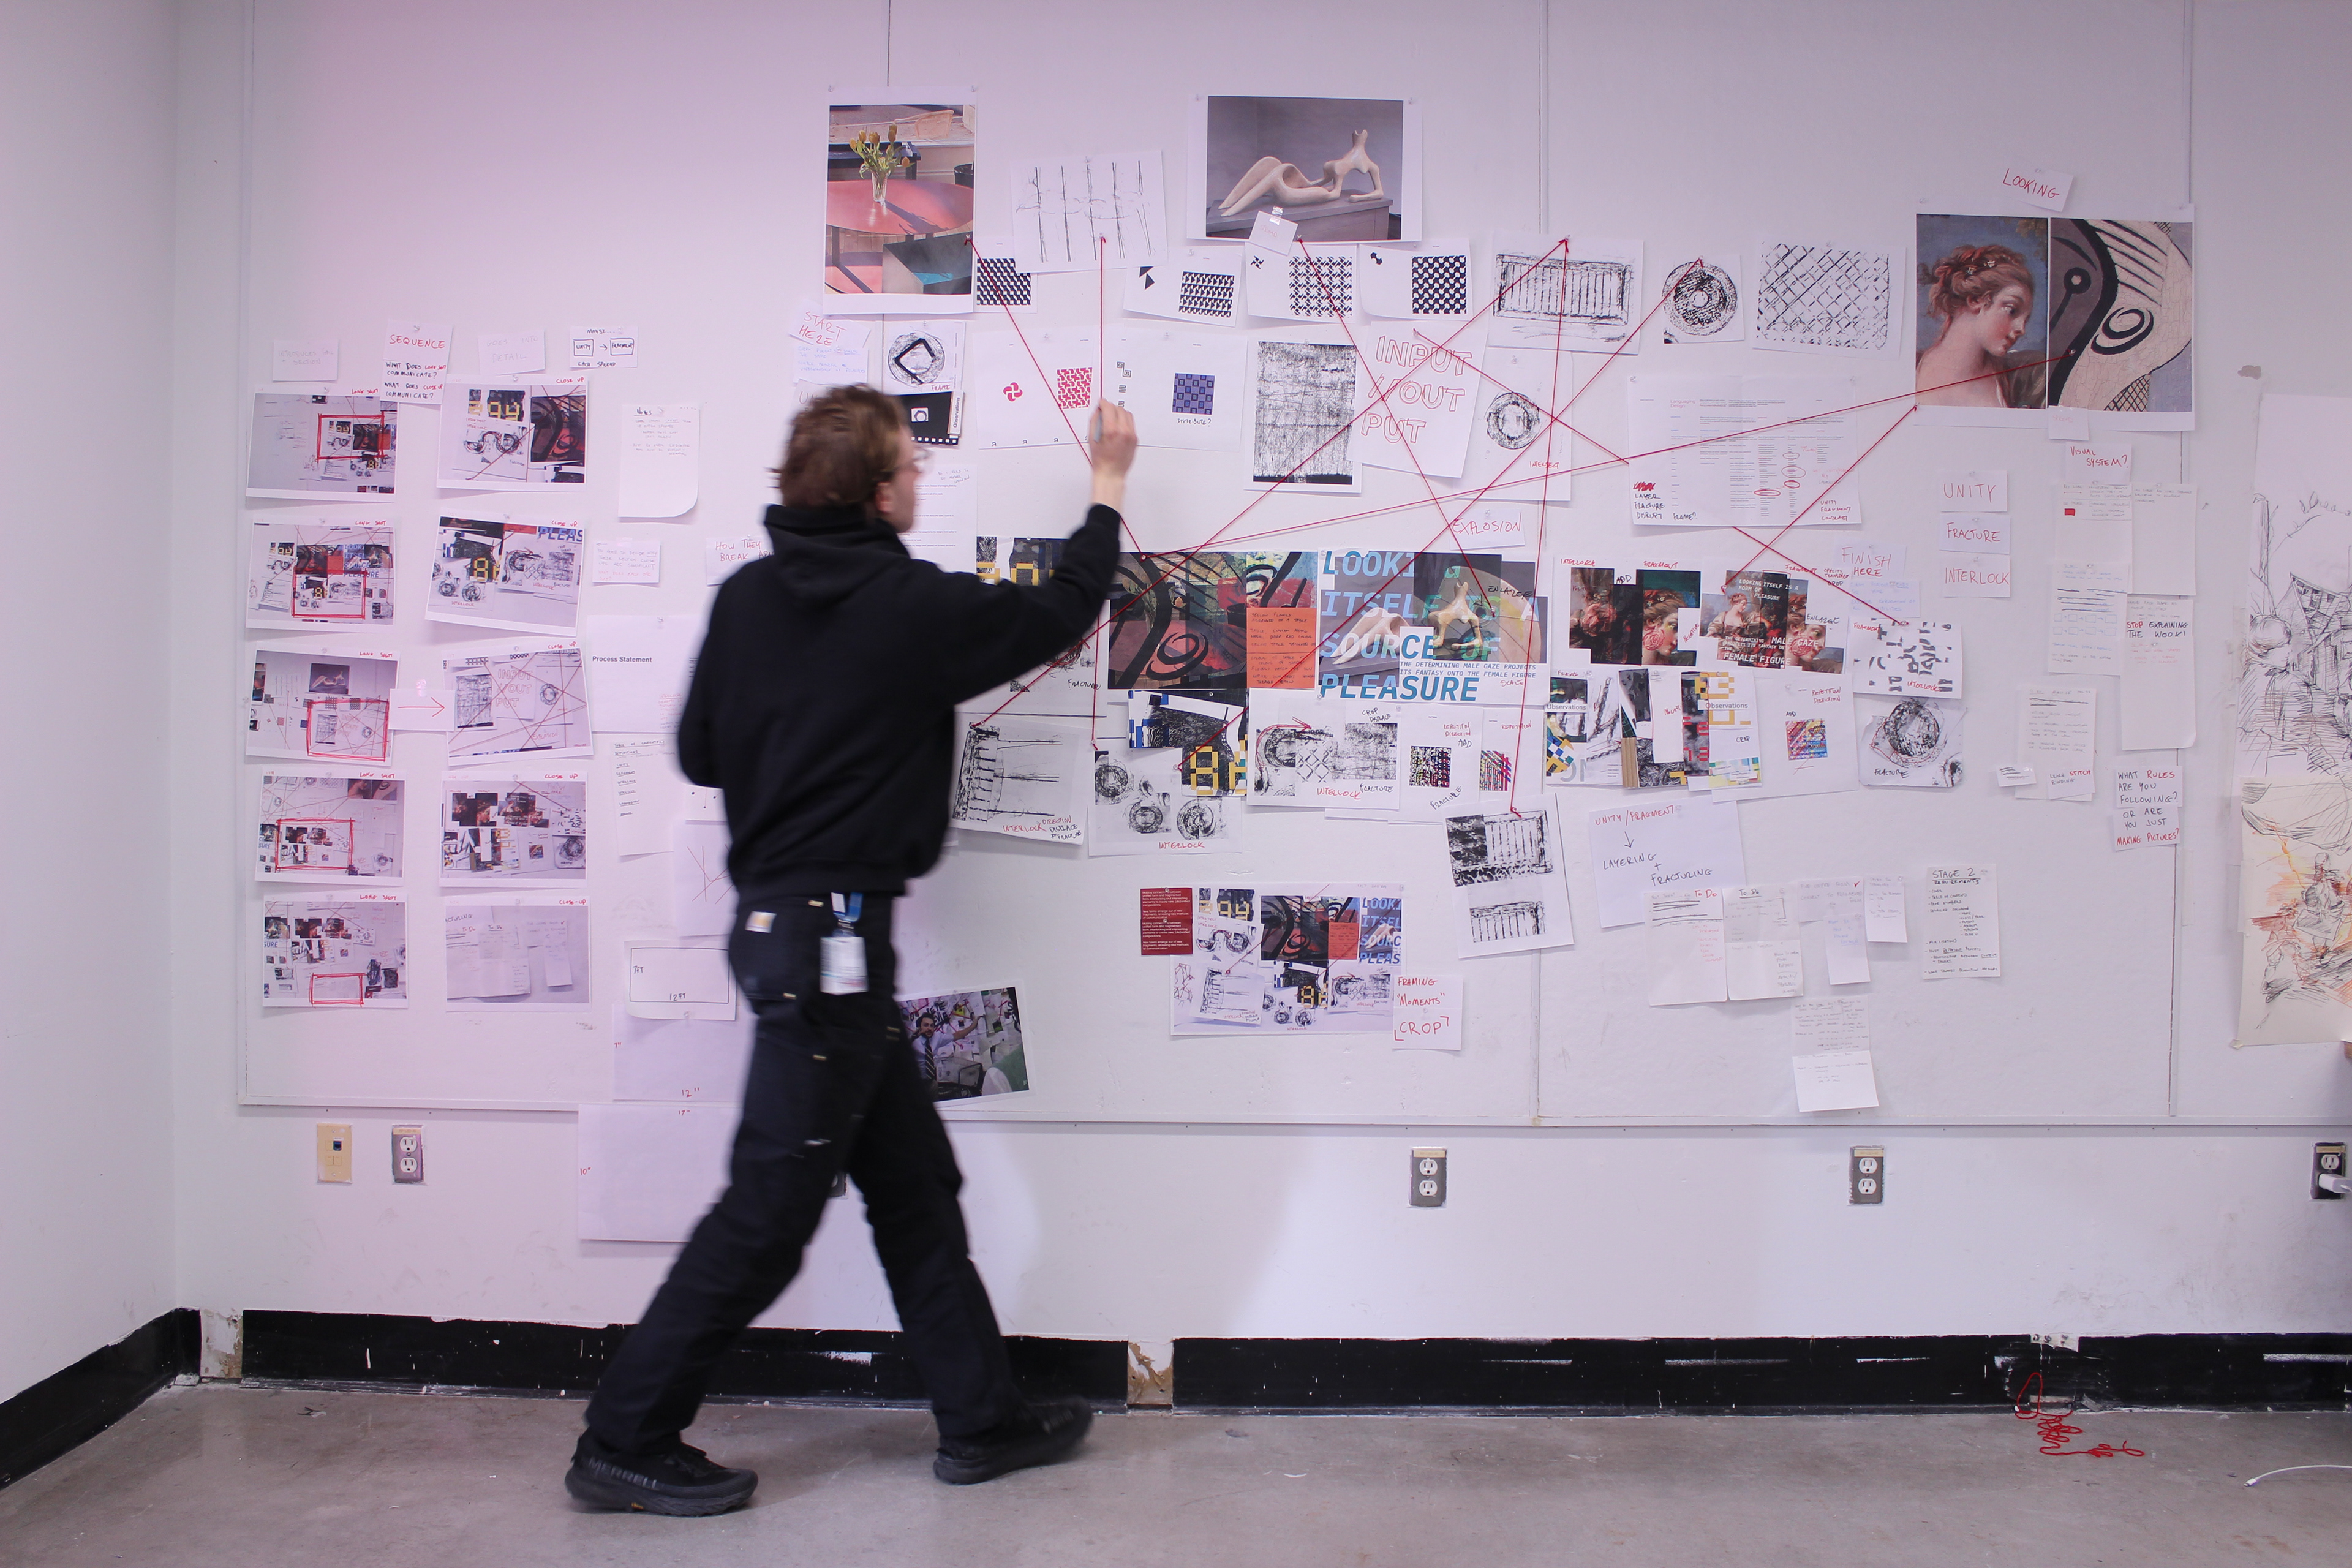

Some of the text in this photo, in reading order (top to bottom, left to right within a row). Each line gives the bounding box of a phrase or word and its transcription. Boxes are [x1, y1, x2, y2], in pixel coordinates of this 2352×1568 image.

[2003, 168, 2059, 198] LOOKING
[804, 311, 847, 341] START
[799, 325, 833, 345] HERE
[389, 334, 445, 349] SEQUENCE
[492, 354, 527, 363] DETAIL
[1376, 335, 1472, 376] INPUT
[1361, 412, 1427, 443] PUT
[2070, 446, 2096, 456] VISUAL
[2086, 454, 2128, 468] SYSTEM?
[1943, 483, 1996, 503] UNITY
[1452, 512, 1521, 535] EXPLOSION
[538, 526, 583, 543] PLEAS
[1946, 522, 2001, 543] FRACTURE
[715, 539, 761, 551] HOW THEY
[720, 552, 748, 561] BREAK
[1842, 546, 1892, 570] FINISH
[1323, 551, 1461, 579] LOOKIG
[1852, 567, 1883, 577] HERE
[1945, 567, 2010, 585] INTERLOCK
[1616, 575, 1632, 584] ADD
[1321, 592, 1442, 619] ITSELF
[1806, 613, 1840, 624] ENLARGE
[1320, 632, 1434, 660] SOURCE
[1797, 639, 1819, 647] GAZE
[1724, 652, 1791, 665] FEMALE FIGURE
[498, 669, 532, 680] INPUT
[1068, 679, 1101, 690] FRACTURE
[1321, 674, 1480, 701] PLEASURE
[495, 697, 519, 708] PUT
[1362, 707, 1379, 716] CROP
[1458, 739, 1472, 748] ADD
[2118, 770, 2175, 780] WHAT RULES
[1360, 783, 1394, 793] FRACTURE
[2119, 782, 2156, 792] ARE YOU
[1317, 788, 1361, 800] INTERLOCK
[1430, 786, 1463, 810] FRACTURE
[2120, 791, 2178, 804] FOLLOWING?
[1042, 815, 1072, 825] DIRECTION
[1595, 815, 1621, 825] UNITY
[2124, 818, 2167, 830] YOU JUST
[1003, 823, 1047, 833] INTERLOCK
[1049, 824, 1078, 832] DISPLACE
[2117, 827, 2179, 846] MAKING PICTURES?
[1158, 841, 1205, 850] INTERLOCK
[1603, 853, 1657, 870] LAYERING
[1651, 869, 1713, 887] FRACTURING
[1932, 867, 1975, 878] STAGE 2
[633, 965, 644, 974] 7FT
[1397, 976, 1438, 987] FRAMING
